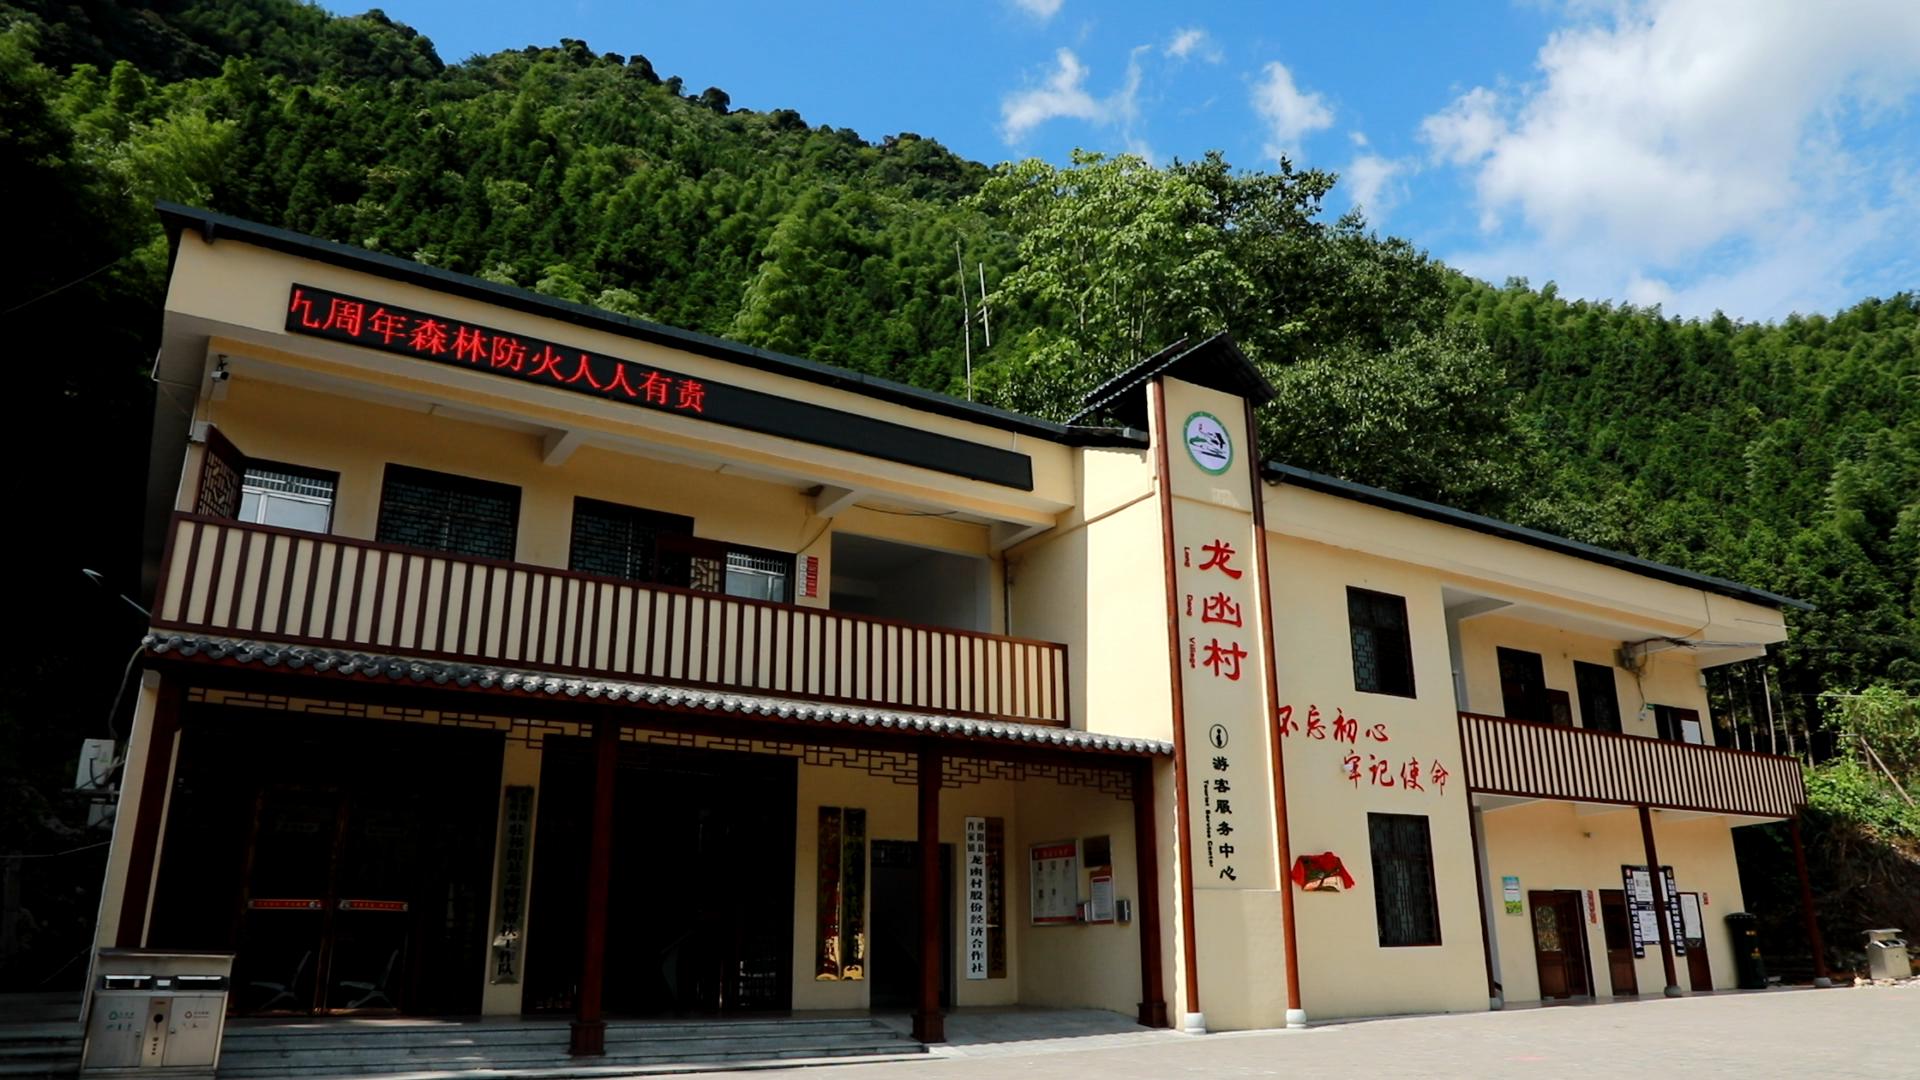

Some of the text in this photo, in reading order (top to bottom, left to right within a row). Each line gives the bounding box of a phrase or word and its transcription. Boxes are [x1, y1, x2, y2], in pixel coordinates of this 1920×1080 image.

[1183, 546, 1197, 669] Long Dang Village
[1198, 538, 1248, 682] 龙凼村
[1278, 705, 1389, 744] 不忘初心
[1343, 750, 1449, 795] 牢记使命
[1212, 756, 1237, 882] 游客服务中心
